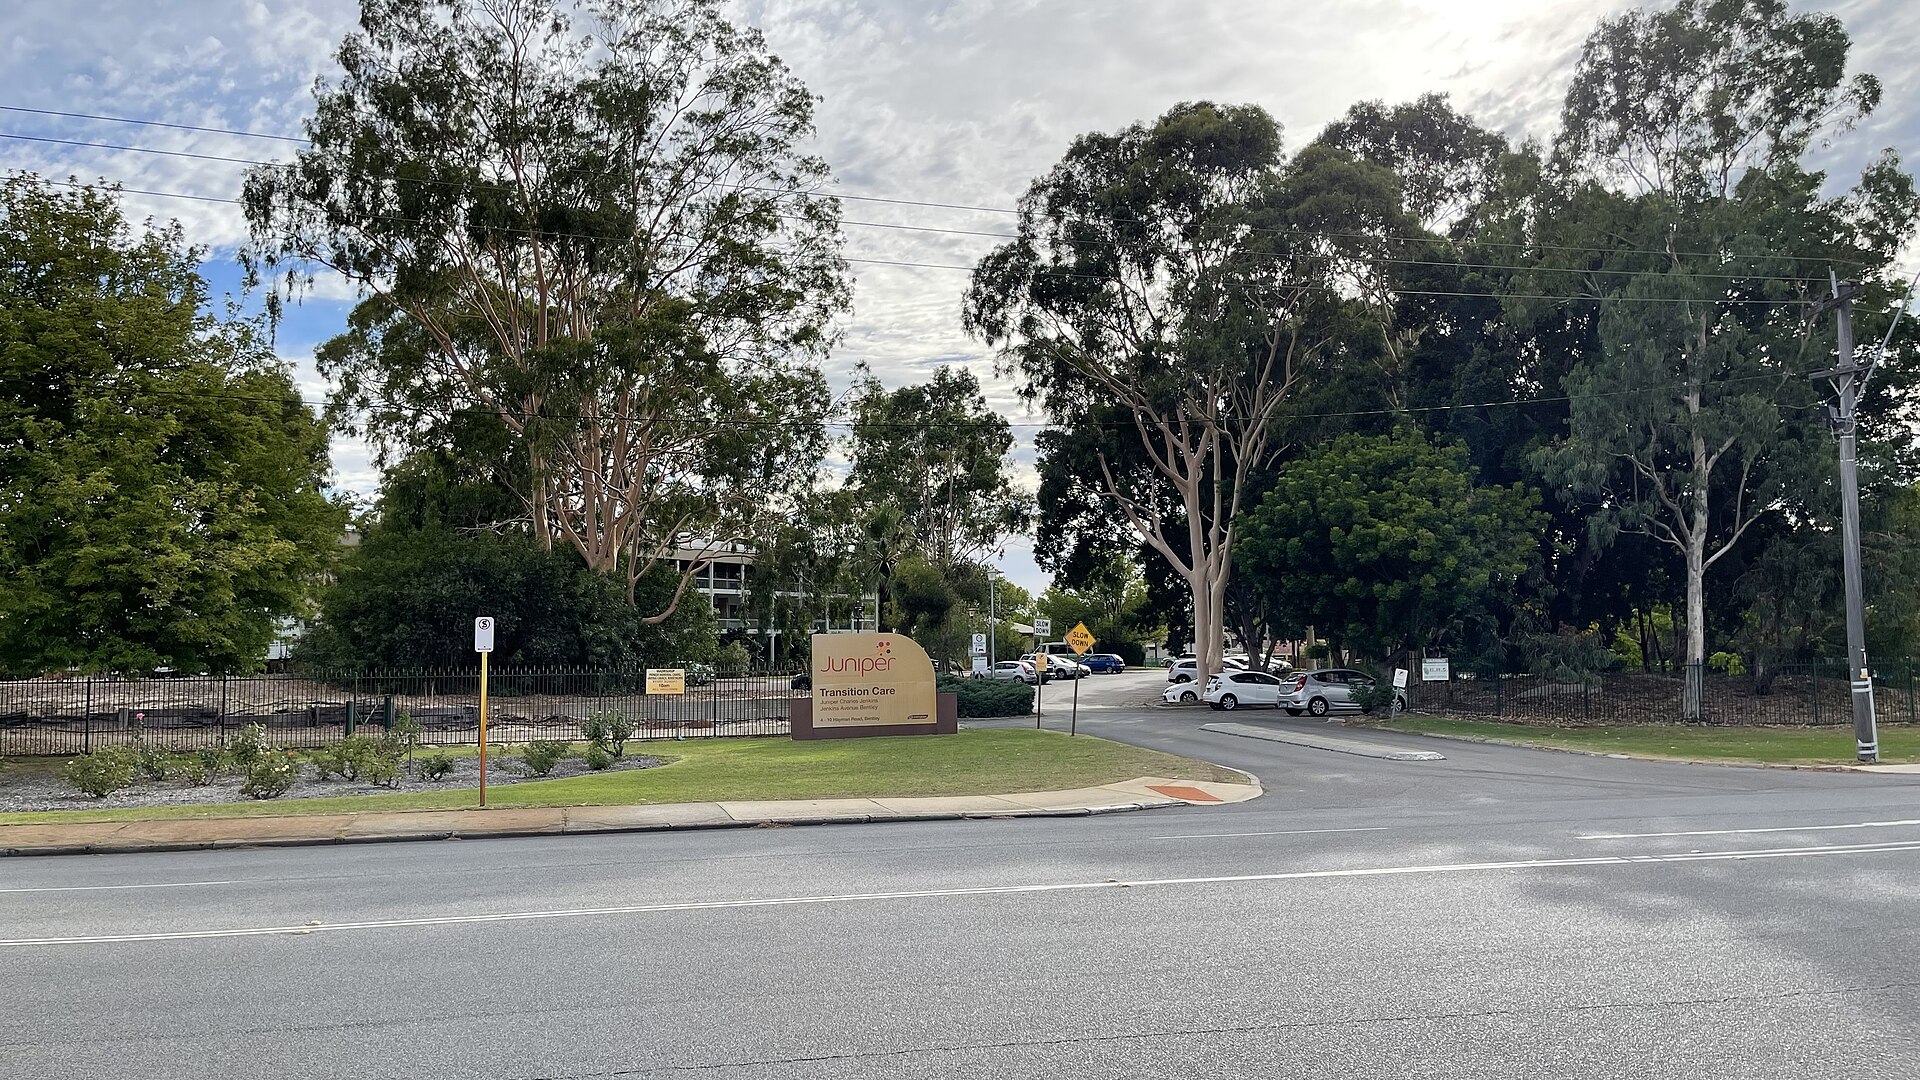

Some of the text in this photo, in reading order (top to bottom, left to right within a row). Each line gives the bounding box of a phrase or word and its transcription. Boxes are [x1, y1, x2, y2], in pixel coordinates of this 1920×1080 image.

[1072, 631, 1089, 639] SLOW
[1071, 639, 1089, 647] DOWN
[820, 655, 896, 677] Juniper
[819, 686, 896, 697] Transition Care
